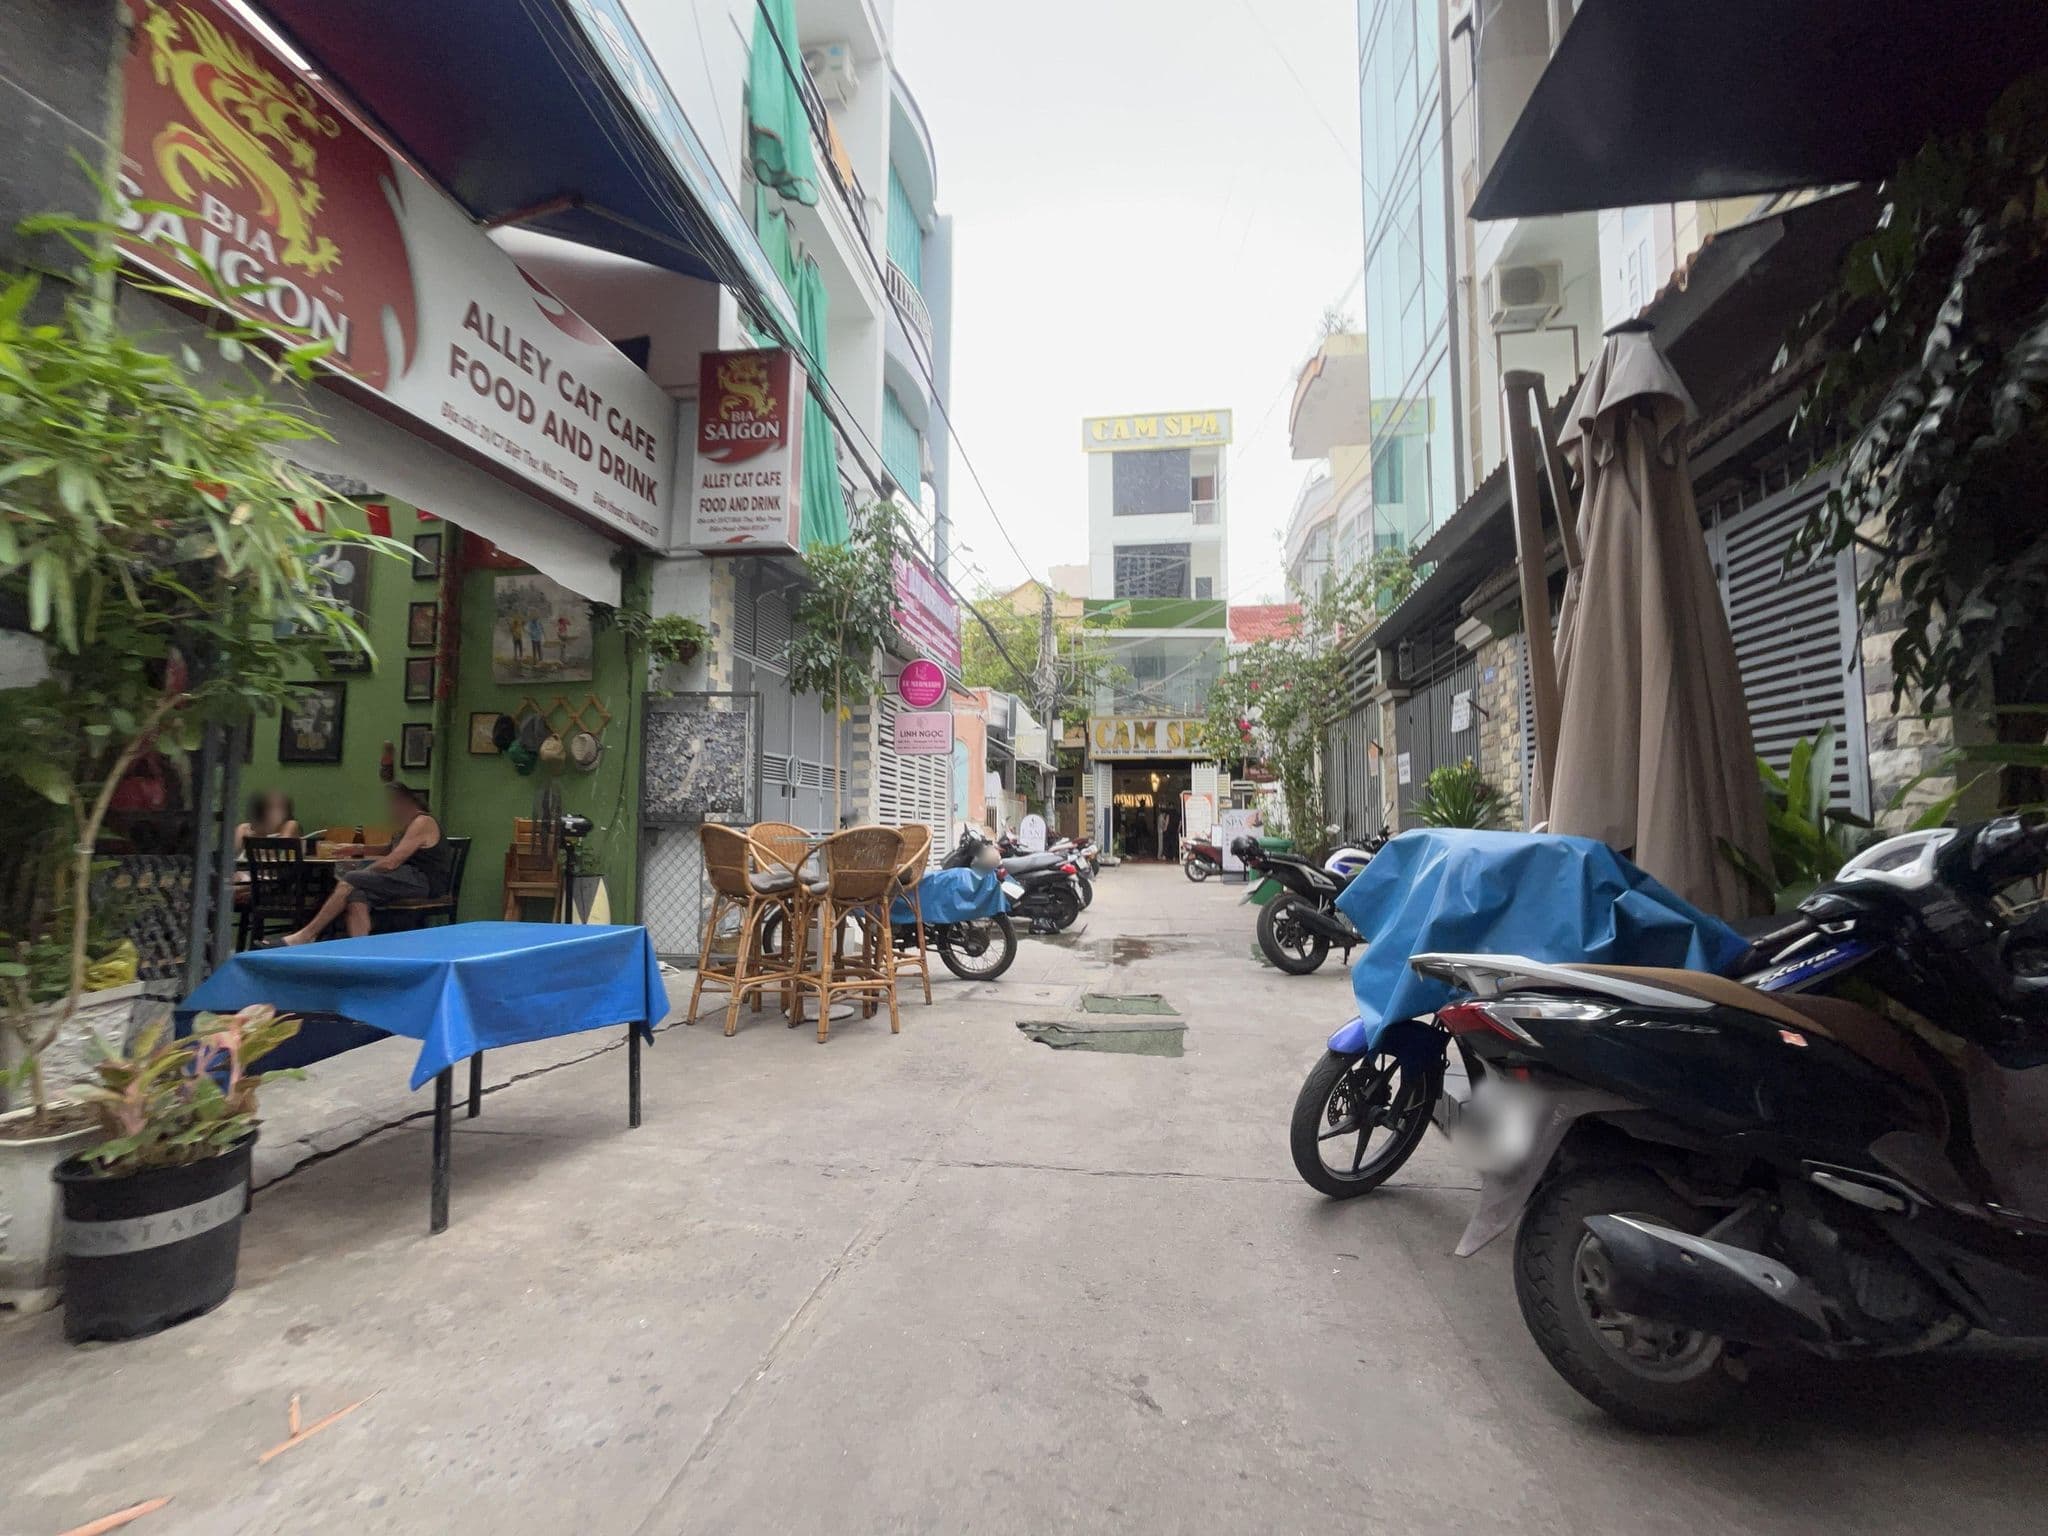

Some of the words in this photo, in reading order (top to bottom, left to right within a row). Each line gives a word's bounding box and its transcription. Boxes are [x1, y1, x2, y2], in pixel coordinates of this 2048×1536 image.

[202, 191, 278, 265] BIA
[116, 172, 349, 354] SAIGON
[463, 300, 552, 384] ALLEY
[557, 370, 602, 421] CAT
[607, 407, 656, 463] CAFE
[450, 343, 536, 424] FOOD
[542, 409, 593, 462] AND
[599, 444, 657, 506] DRINK
[731, 411, 754, 422] BIA
[1091, 416, 1157, 441] CAM
[1164, 413, 1220, 437] SPA
[704, 421, 780, 441] SAIGON
[702, 472, 732, 488] ALLEY
[734, 472, 754, 487] CAT
[756, 471, 781, 487] CAFE
[699, 497, 727, 513] FOOD
[729, 496, 749, 512] AND
[751, 496, 781, 511] DRINK
[900, 730, 917, 738] LINH
[1095, 720, 1157, 749] CAM
[1167, 720, 1206, 749] SP
